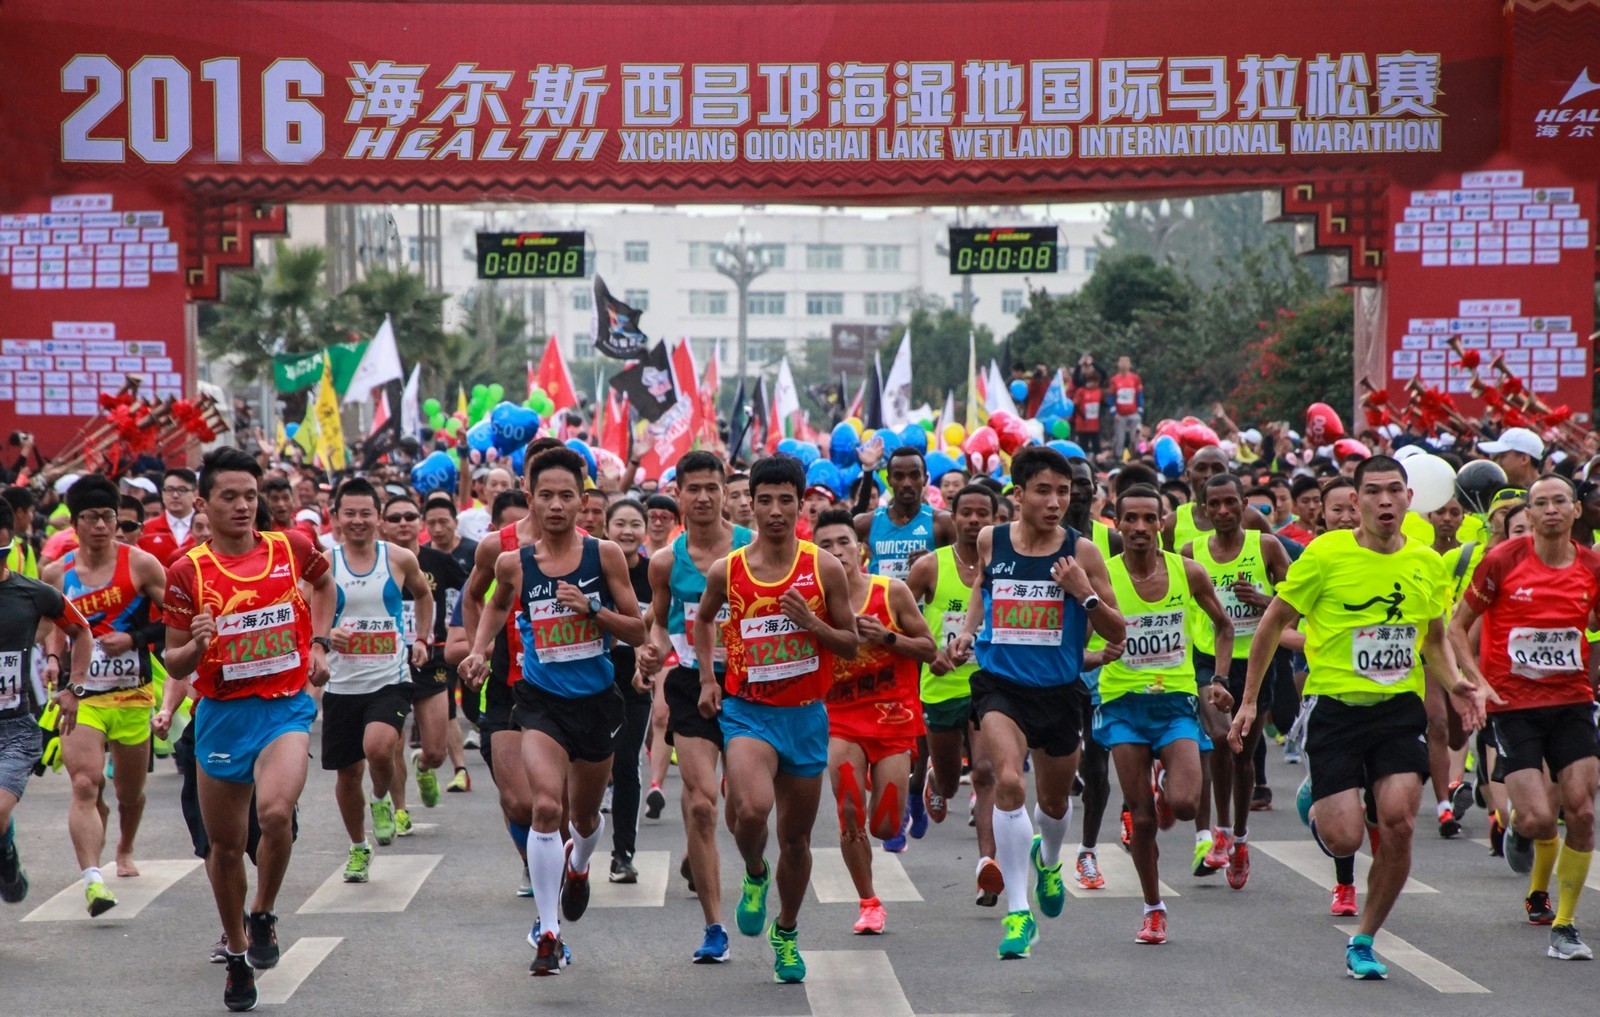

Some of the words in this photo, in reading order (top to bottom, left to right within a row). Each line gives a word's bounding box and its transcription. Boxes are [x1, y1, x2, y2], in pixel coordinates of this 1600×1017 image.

[60, 53, 325, 164] 2016
[344, 59, 609, 127] 海尔斯
[620, 50, 1448, 128] 西昌邛海湿地国际马拉松赛
[343, 127, 607, 161] HEALTH
[618, 127, 738, 163] XICHANG
[744, 126, 870, 163] QIONGHAI
[876, 126, 945, 161] LAKE
[950, 124, 1074, 160] WETLAND
[1078, 121, 1286, 158] INTERNATIONAL
[1290, 118, 1443, 155] MARATHON
[484, 252, 578, 275] 0:00:08
[957, 247, 1051, 270] 0:00:08
[1012, 583, 1062, 598] 海尔斯
[242, 607, 291, 630] 海尔斯
[356, 619, 394, 631] 海尔斯
[994, 605, 1060, 629] 14078
[1140, 611, 1183, 629] 海尔斯
[537, 619, 600, 647] 14075
[1126, 631, 1181, 656] 00012
[1376, 626, 1417, 641] 海尔斯
[226, 629, 294, 663] 12435
[749, 636, 815, 665] 12434
[1357, 647, 1412, 671] 04203
[1515, 649, 1578, 667] 04381
